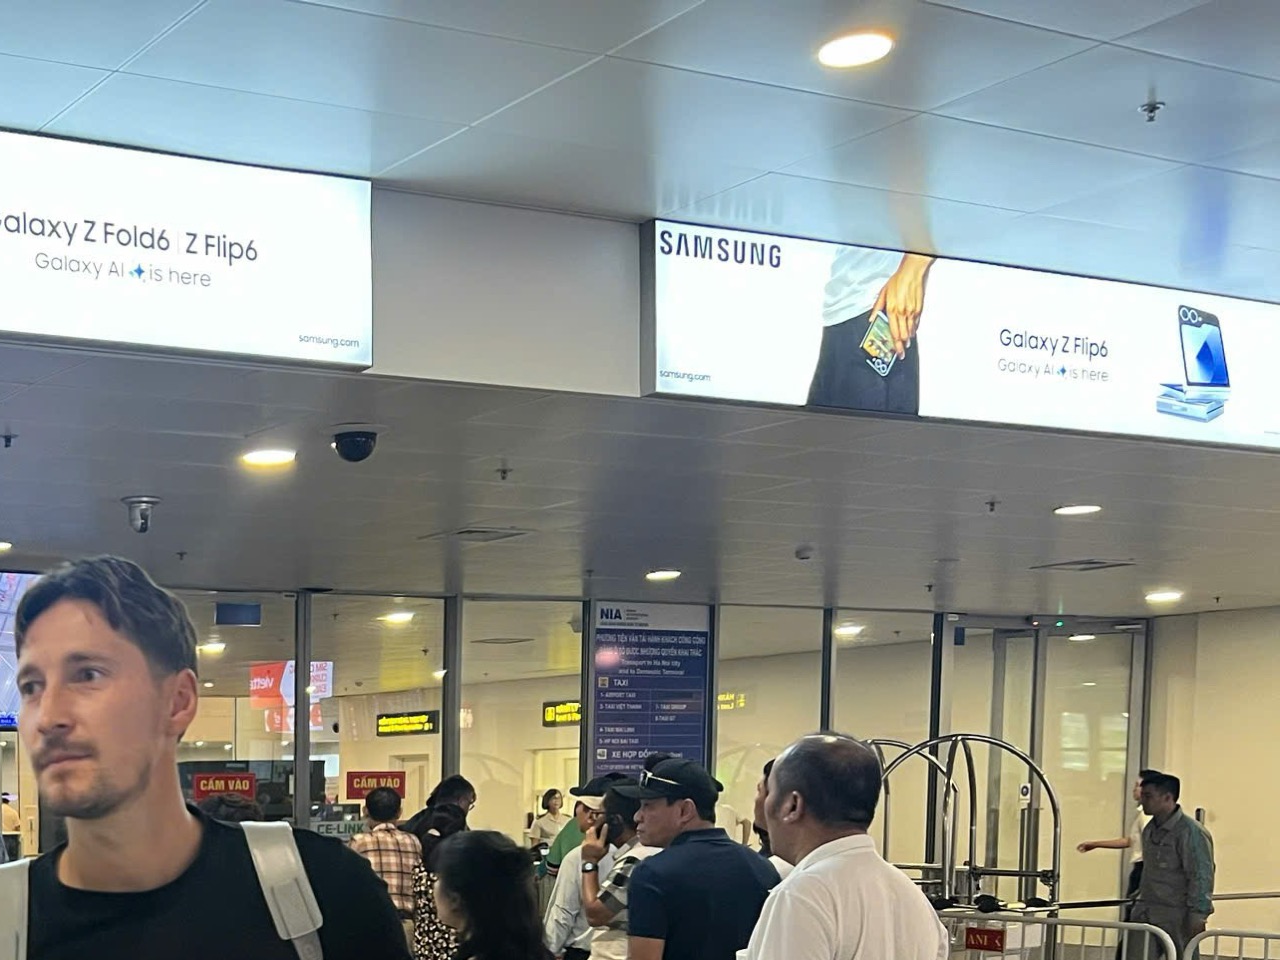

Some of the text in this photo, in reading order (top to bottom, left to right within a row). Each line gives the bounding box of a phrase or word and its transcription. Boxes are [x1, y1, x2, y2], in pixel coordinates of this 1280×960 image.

[84, 220, 96, 242] Z
[104, 222, 170, 251] Fold6
[186, 232, 198, 254] Z
[205, 234, 258, 266] Flip6
[660, 230, 782, 269] SAMSUNG
[35, 252, 211, 286] Galaxy AI is here
[299, 335, 360, 349] samsung.com
[999, 329, 1109, 361] Galaxy Z Flip6
[659, 369, 711, 382] samsung.com
[997, 358, 1109, 382] Galaxy AI is here
[600, 608, 622, 620] NIA
[613, 678, 629, 687] TAXI
[612, 750, 621, 758] XE
[200, 774, 250, 791] CẤM VÀO
[353, 774, 401, 789] CẤM VÀO
[317, 823, 364, 834] CE-LINK
